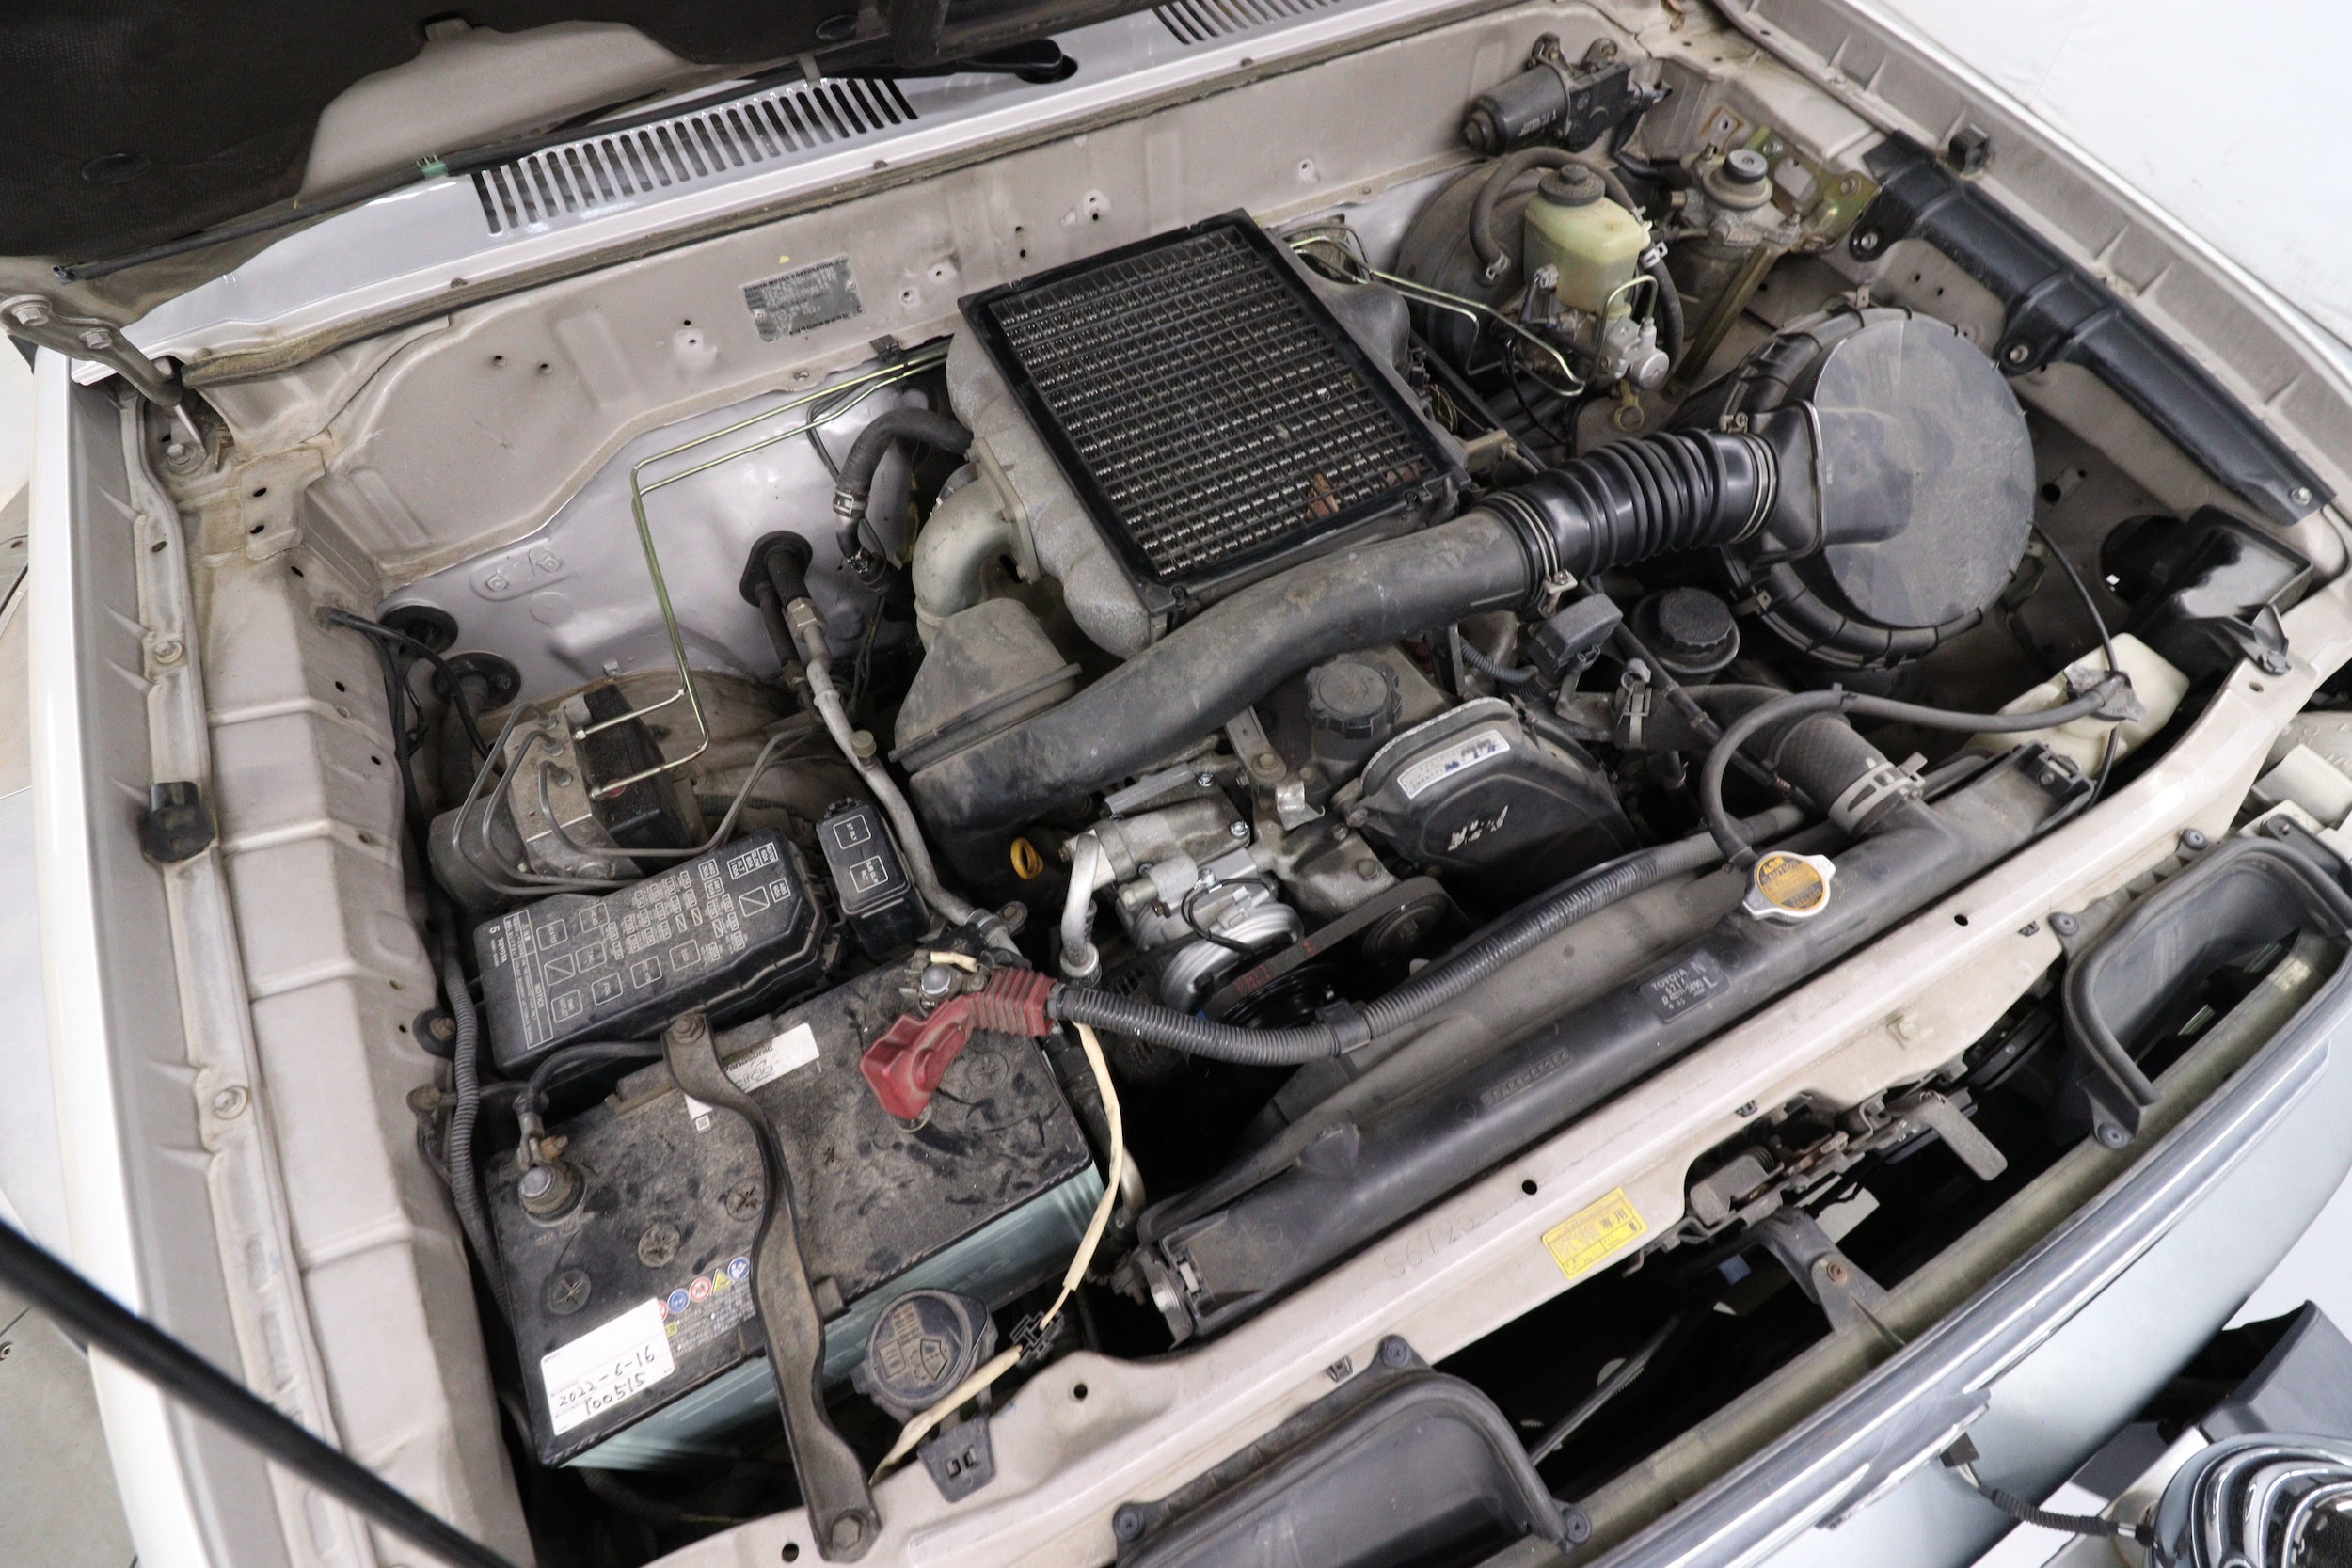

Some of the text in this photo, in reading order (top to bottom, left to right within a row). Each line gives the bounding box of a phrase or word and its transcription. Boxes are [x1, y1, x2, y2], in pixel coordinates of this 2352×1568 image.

[791, 263, 834, 279] CORPORATION
[497, 937, 508, 964] TOYOTA
[1651, 968, 1687, 990] TOYOTA
